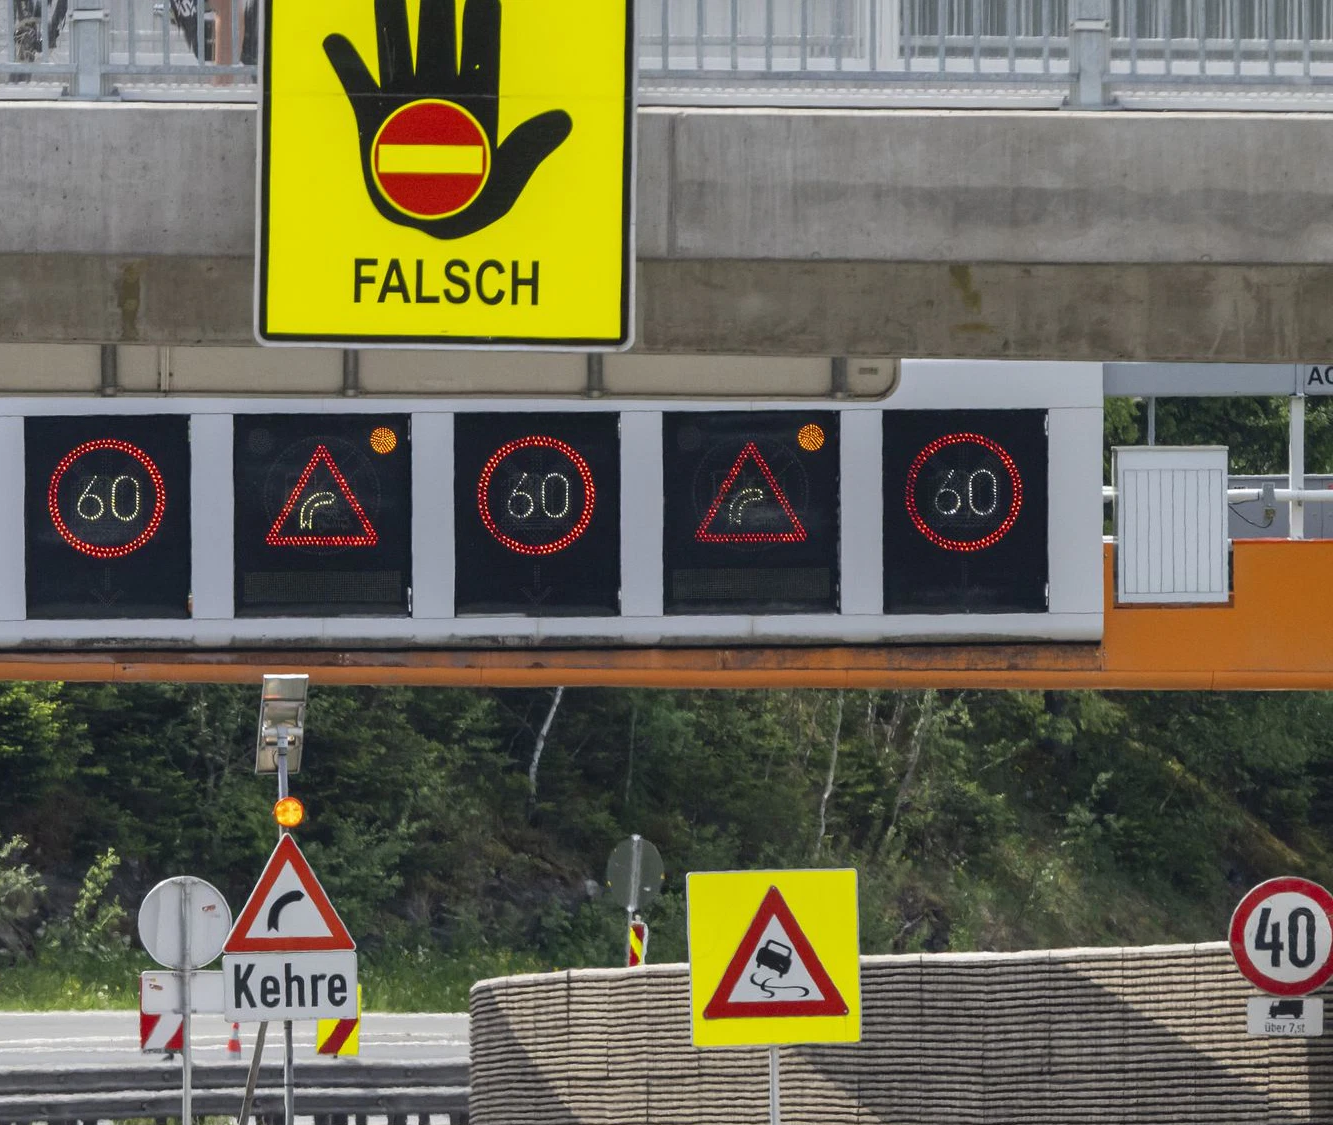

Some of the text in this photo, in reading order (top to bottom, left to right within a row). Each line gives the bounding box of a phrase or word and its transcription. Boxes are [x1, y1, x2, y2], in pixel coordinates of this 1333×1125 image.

[354, 258, 539, 305] FALSCH
[76, 475, 140, 522] 60
[507, 473, 570, 520] 60
[935, 469, 998, 516] 60
[1254, 907, 1316, 968] 40
[234, 962, 348, 1009] Kehre
[1265, 1022, 1286, 1033] über
